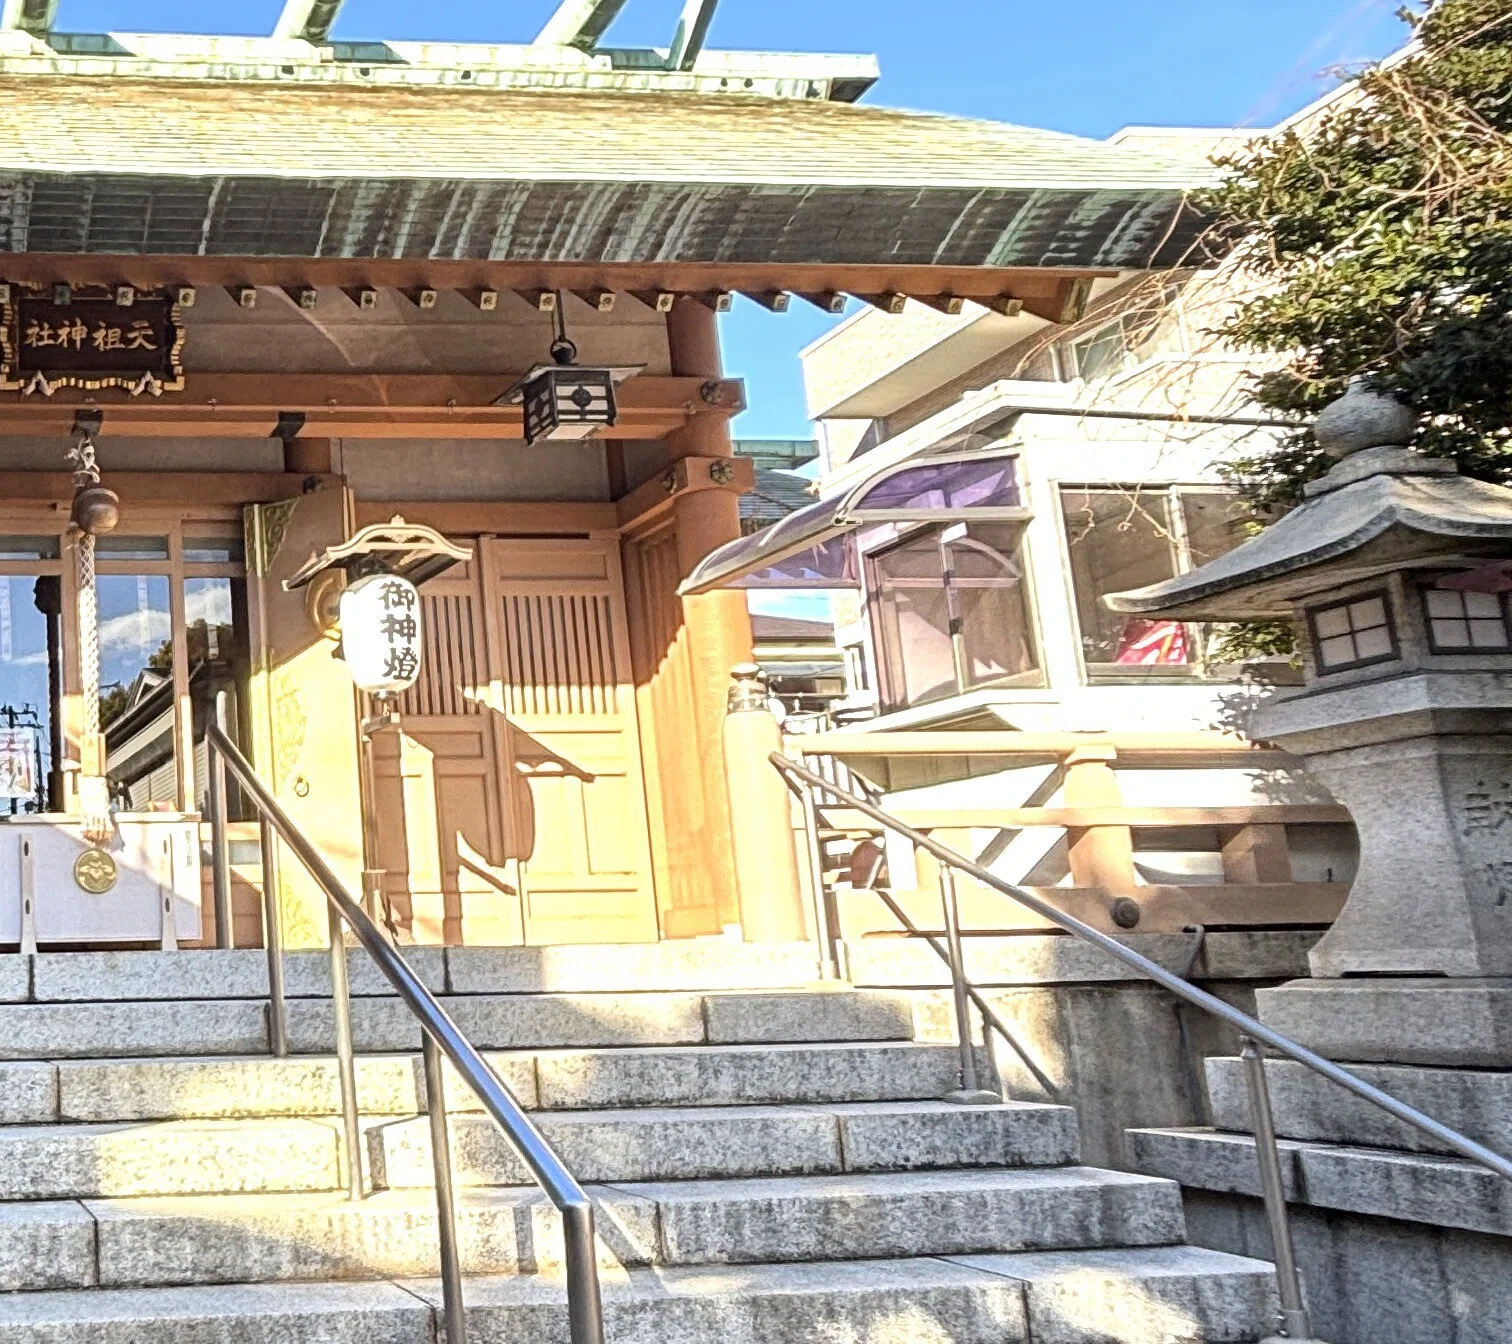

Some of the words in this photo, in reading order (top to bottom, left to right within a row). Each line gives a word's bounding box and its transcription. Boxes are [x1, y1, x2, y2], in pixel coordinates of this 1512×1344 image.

[25, 318, 157, 351] 天祖神社
[379, 581, 418, 681] 御神燈
